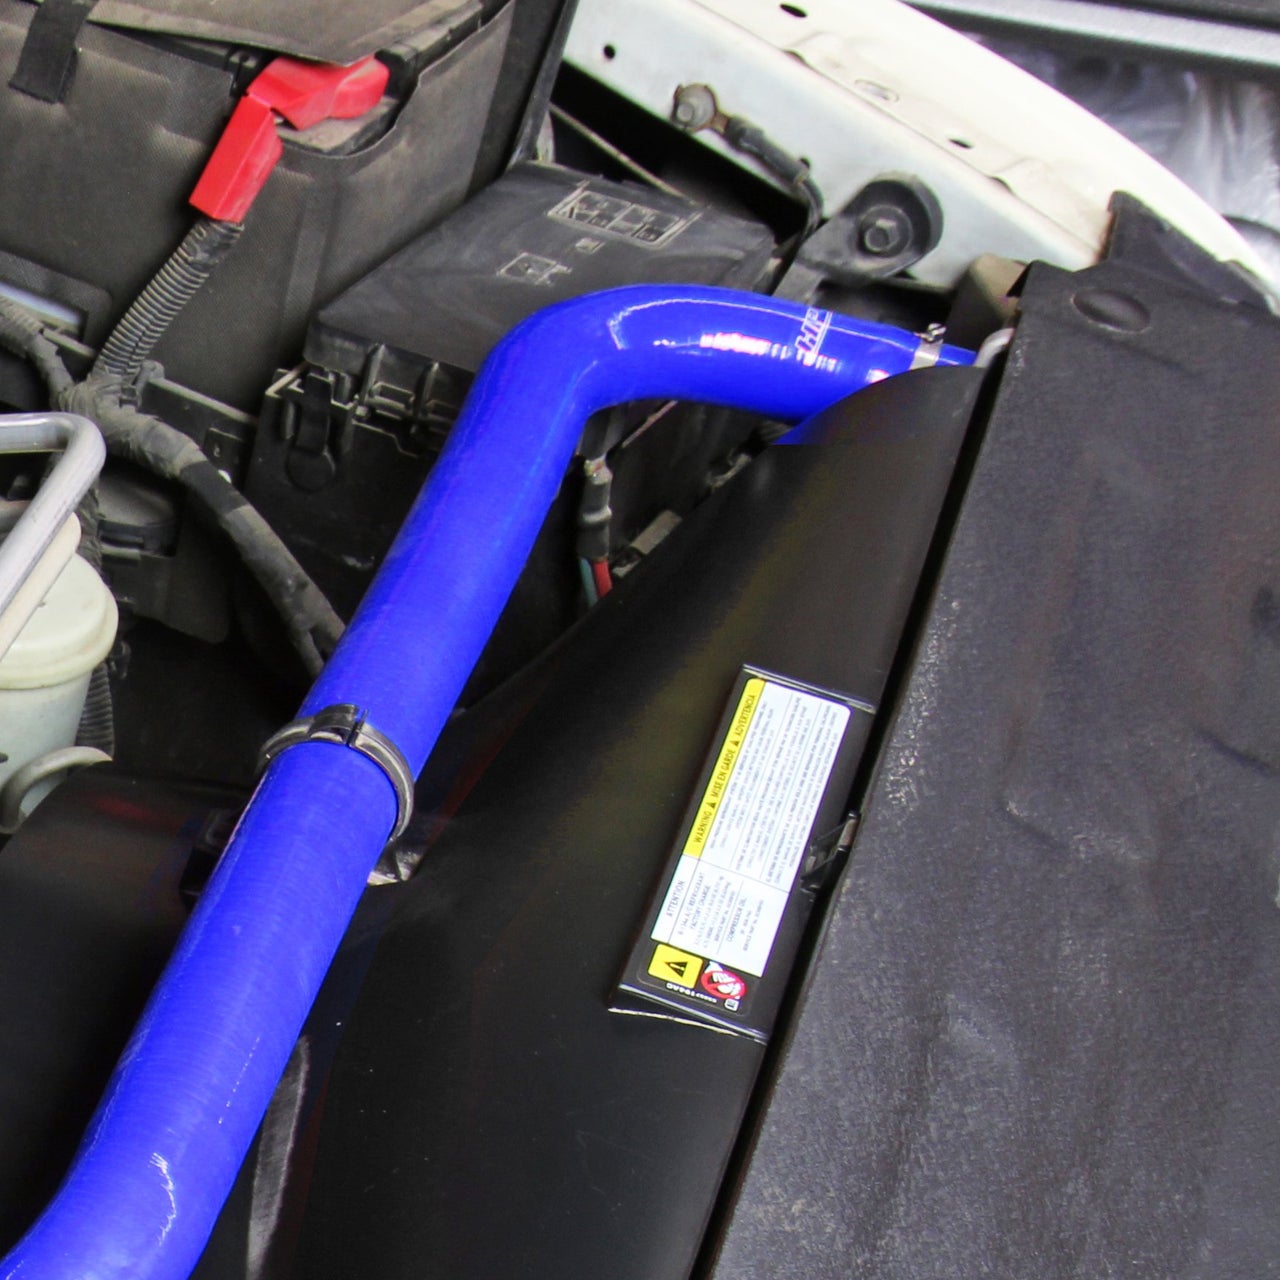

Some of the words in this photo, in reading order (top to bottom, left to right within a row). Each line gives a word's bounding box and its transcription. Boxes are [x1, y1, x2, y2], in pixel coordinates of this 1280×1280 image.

[732, 692, 757, 737] ADVERTENCIA
[719, 747, 736, 771] GARDE
[709, 779, 724, 798] MISE
[716, 769, 728, 780] EN
[692, 809, 713, 844] WARNING
[664, 879, 685, 917] ATTENTION
